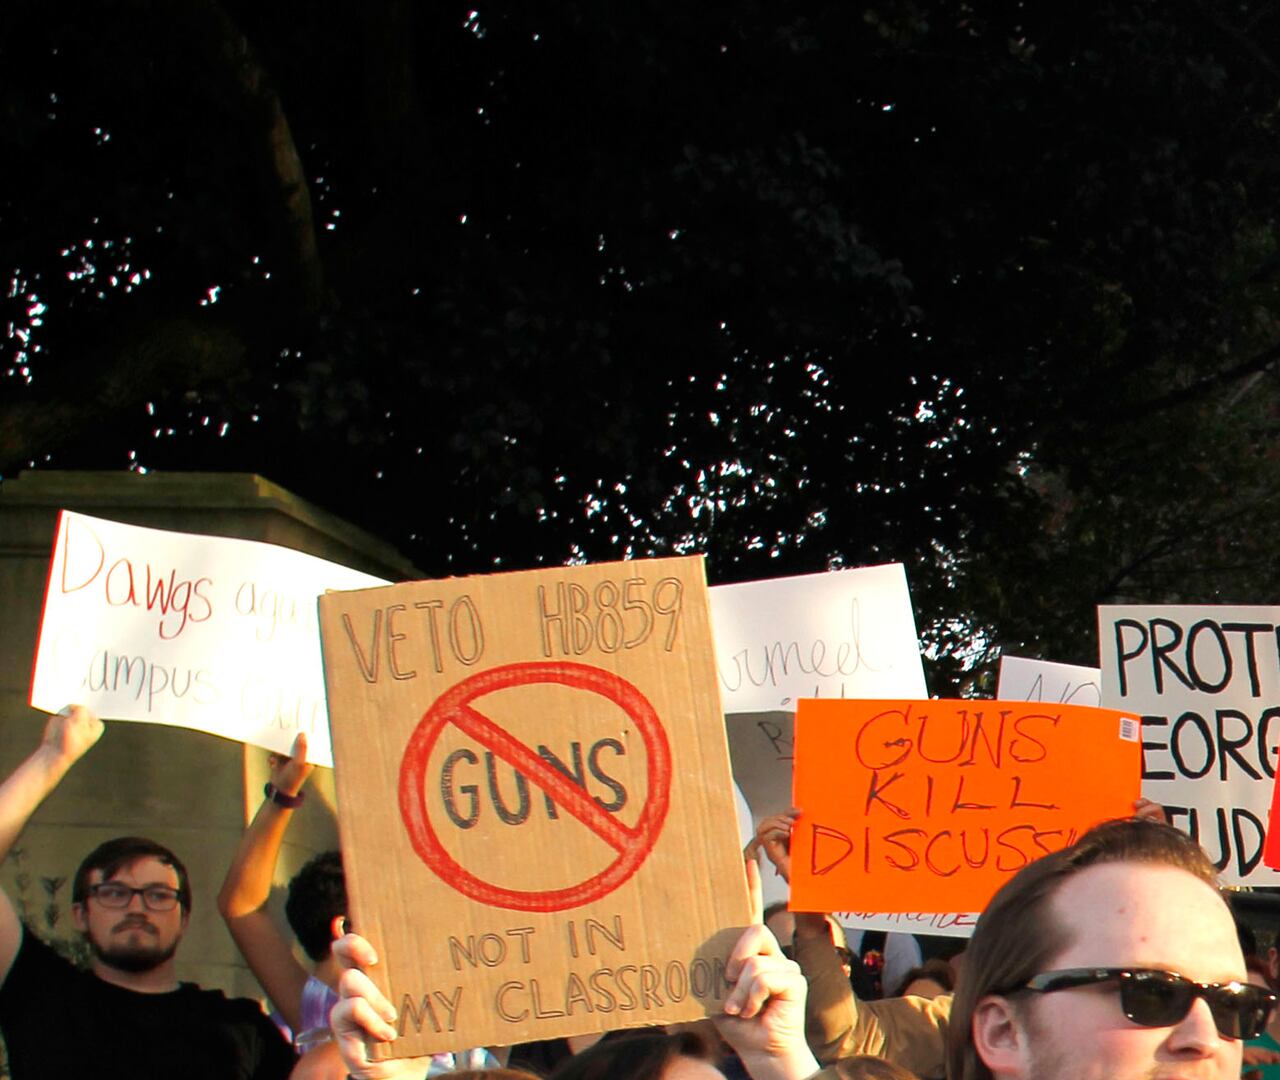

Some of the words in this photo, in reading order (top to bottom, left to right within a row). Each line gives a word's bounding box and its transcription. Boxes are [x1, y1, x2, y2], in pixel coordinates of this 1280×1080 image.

[343, 595, 485, 684] VETO
[537, 576, 683, 657] HB859
[856, 705, 1063, 770] GUNS
[440, 737, 629, 830] GUNS
[864, 771, 1061, 820] KILL
[449, 926, 535, 971] NOT
[568, 914, 627, 958] IN
[398, 985, 464, 1038] MY
